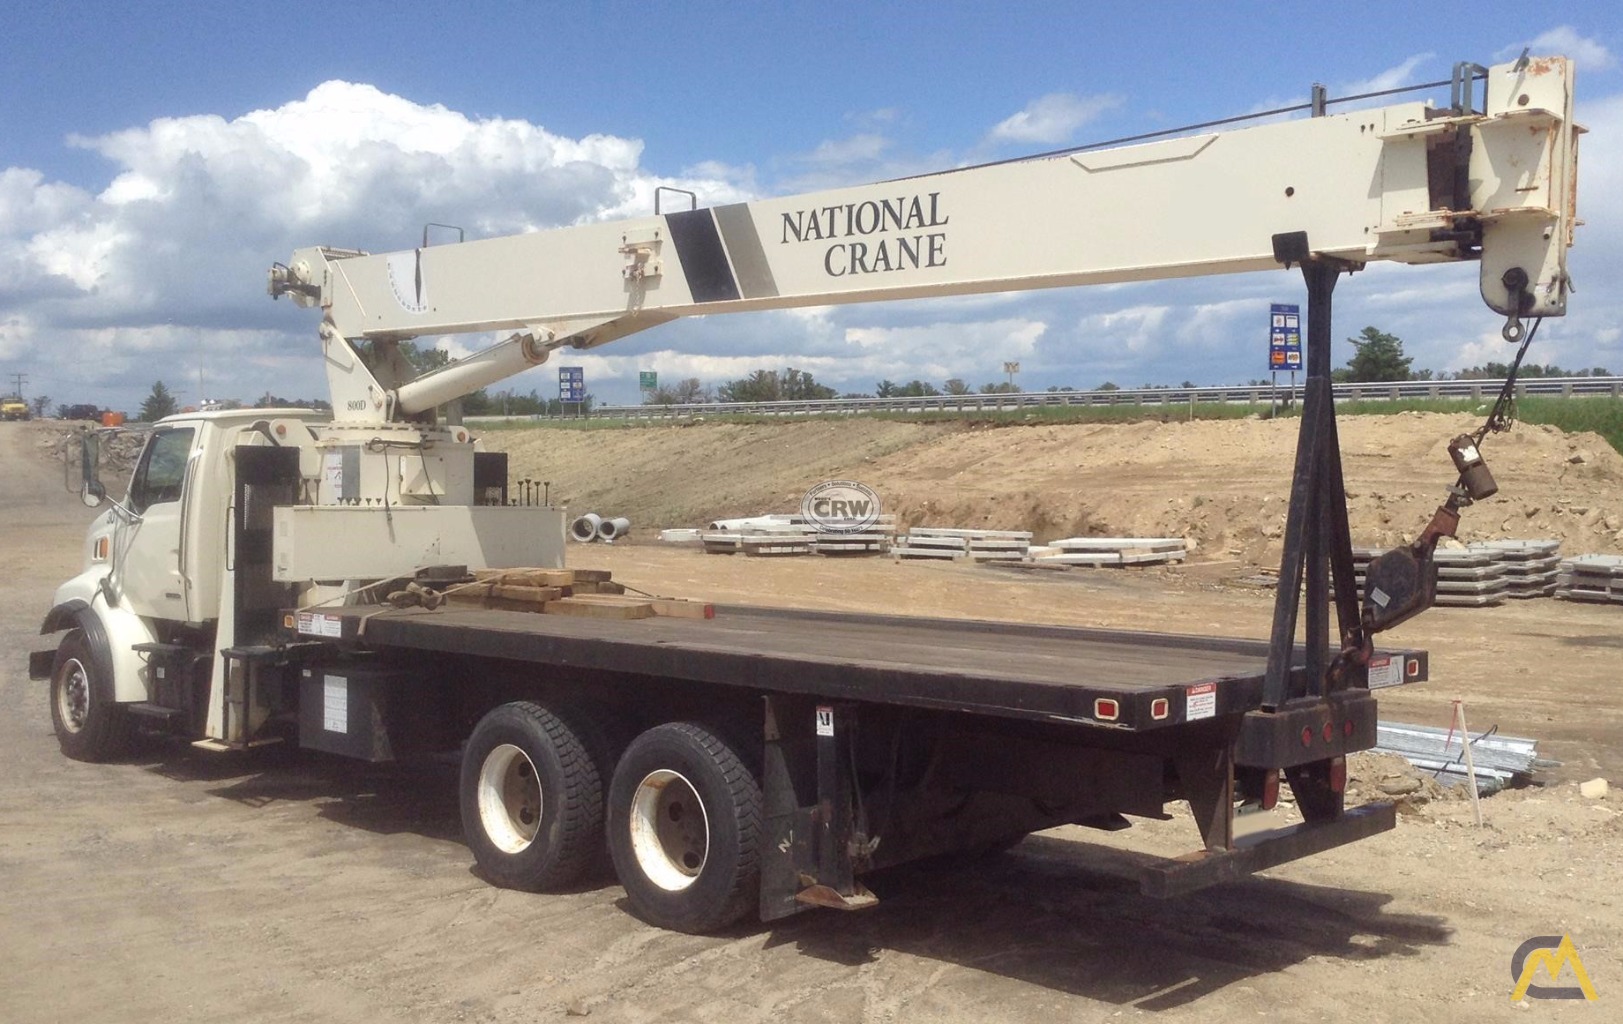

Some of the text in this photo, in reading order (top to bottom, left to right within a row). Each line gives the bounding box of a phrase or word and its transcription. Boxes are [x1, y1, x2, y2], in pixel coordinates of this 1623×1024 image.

[781, 192, 949, 244] NATIONAL
[824, 233, 947, 277] CRANE
[347, 400, 367, 411] 800D
